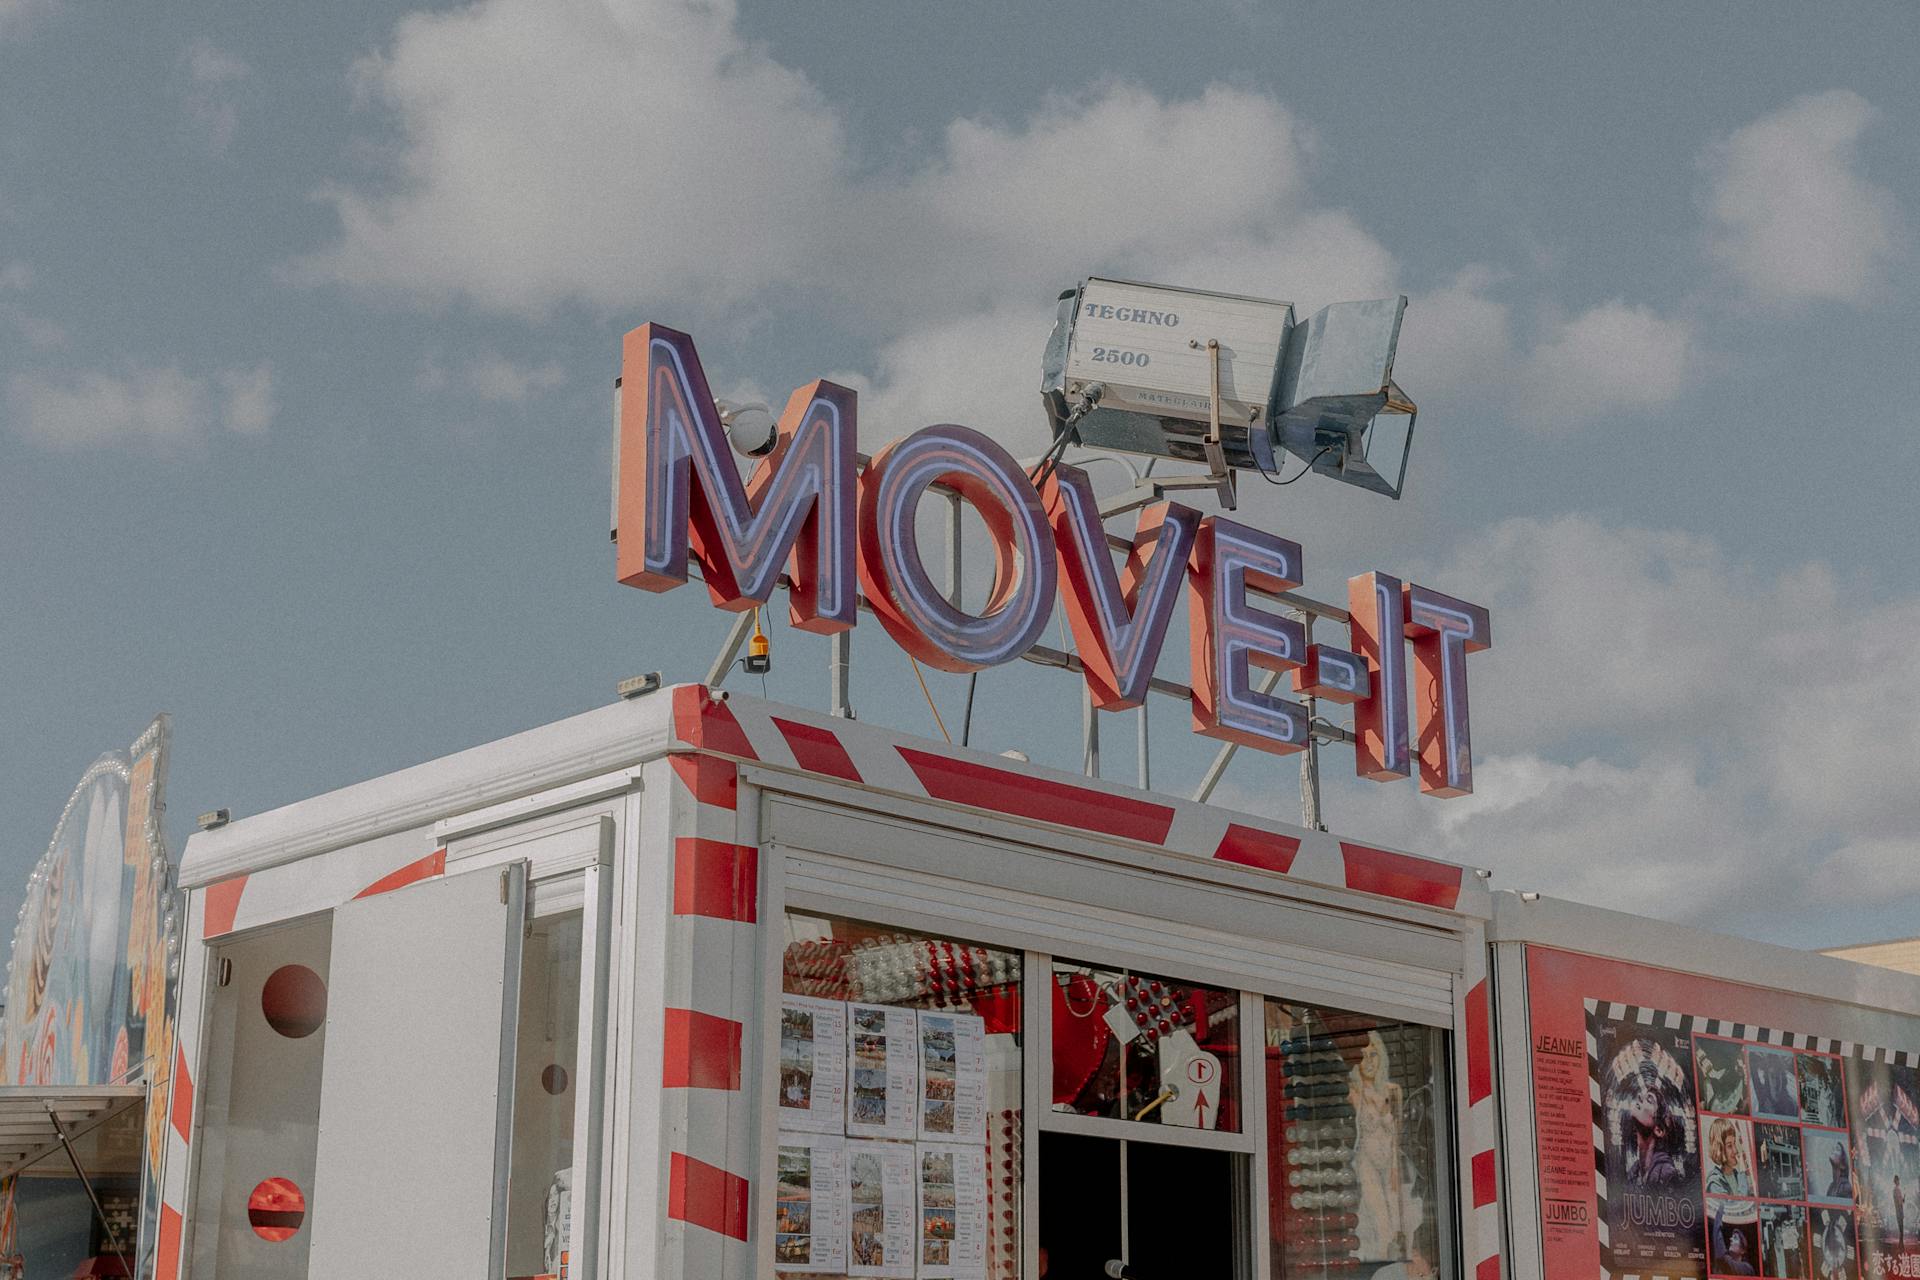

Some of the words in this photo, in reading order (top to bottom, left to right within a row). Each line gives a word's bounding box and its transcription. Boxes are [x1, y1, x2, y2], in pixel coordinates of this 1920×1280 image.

[1091, 346, 1151, 368] 2500
[617, 321, 1491, 799] MOVE-IT
[1620, 1193, 1696, 1230] JUMBO
